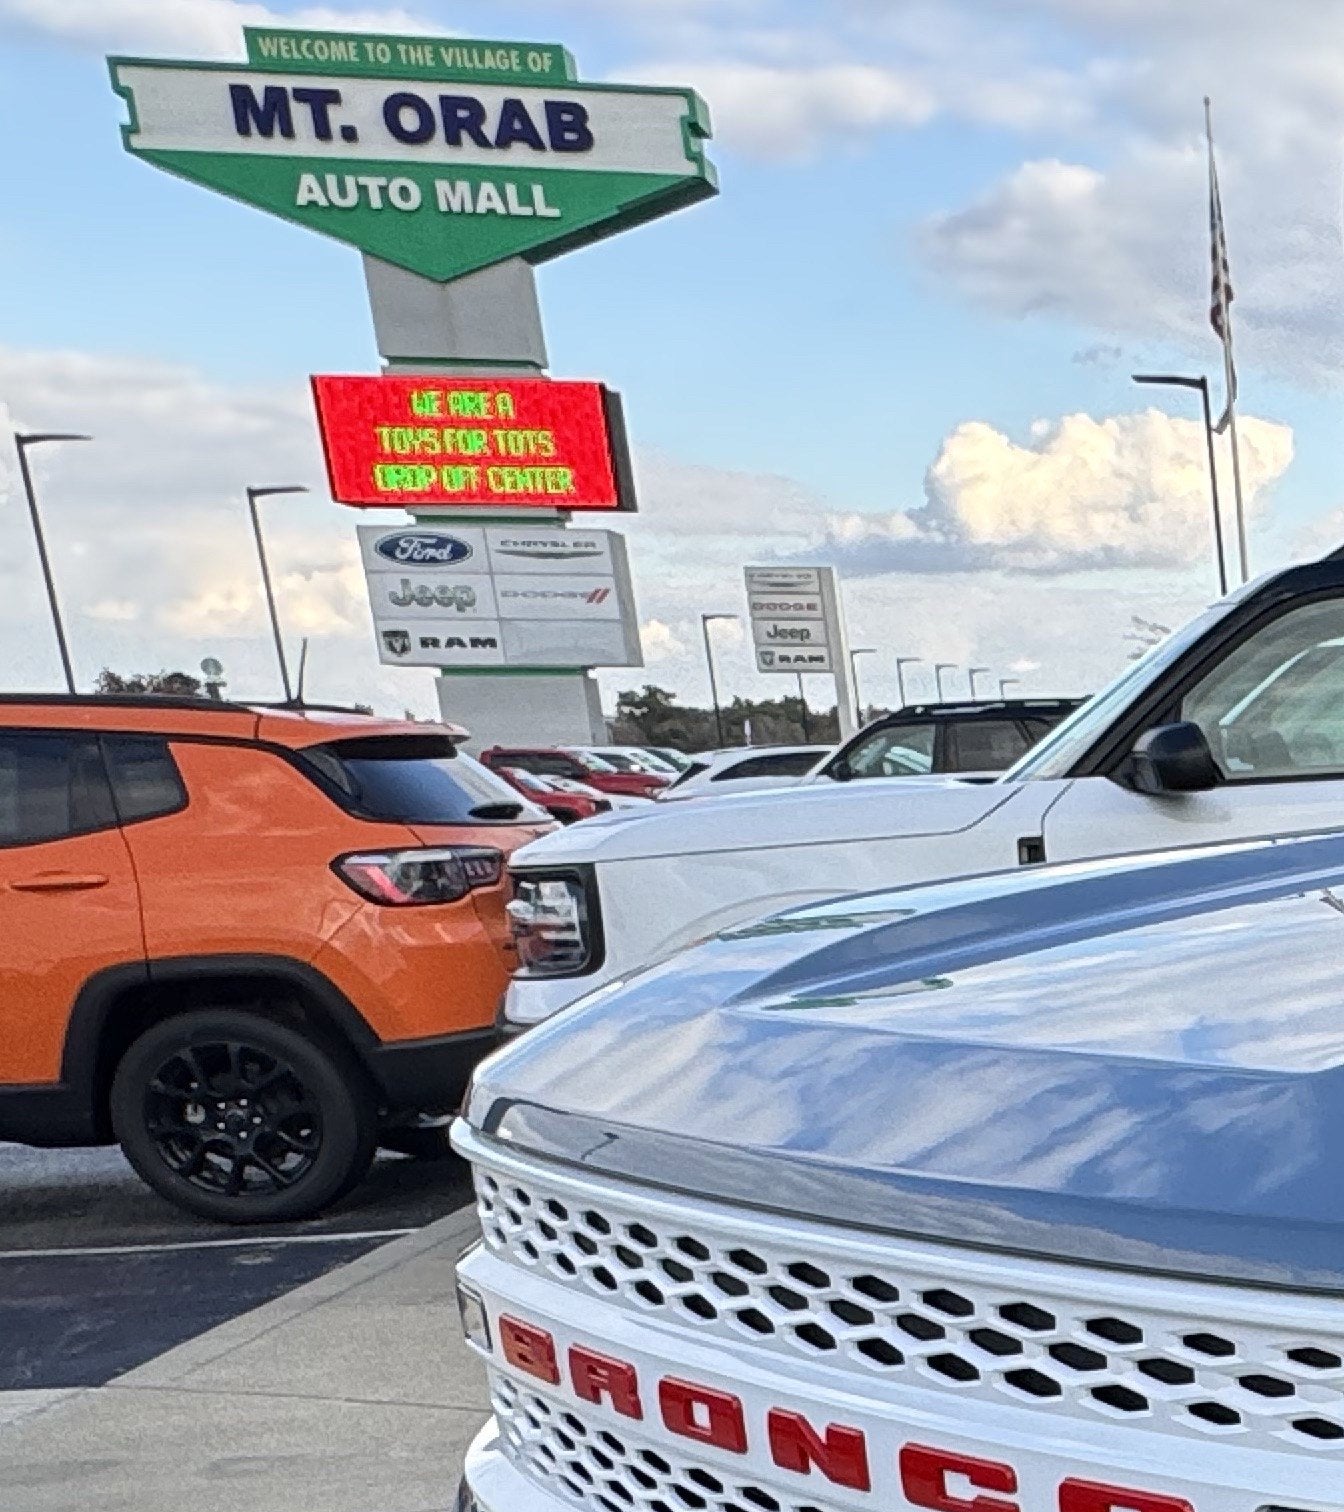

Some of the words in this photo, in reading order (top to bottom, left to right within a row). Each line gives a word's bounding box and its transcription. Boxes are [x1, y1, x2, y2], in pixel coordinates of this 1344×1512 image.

[258, 37, 359, 62] WELCOME
[364, 43, 392, 64] TO
[398, 44, 435, 67] THE
[441, 47, 520, 72] VILLAGE
[527, 51, 552, 73] OF
[229, 84, 358, 143] MT.
[383, 92, 594, 152] ORAB
[296, 173, 422, 212] AUTO
[434, 179, 563, 218] MALL
[411, 390, 443, 417] WE
[447, 390, 493, 419] ARE
[496, 391, 516, 419] A
[375, 426, 441, 455] TOYS
[442, 428, 490, 457] FOR
[492, 429, 556, 457] TOTS
[374, 462, 437, 492] DROP
[441, 464, 480, 493] OFF
[486, 464, 576, 494] CENTER
[393, 533, 455, 563] Ford
[388, 579, 477, 612] Jeep
[419, 637, 498, 650] RAM
[766, 624, 811, 642] Jeep
[778, 654, 825, 664] RAM
